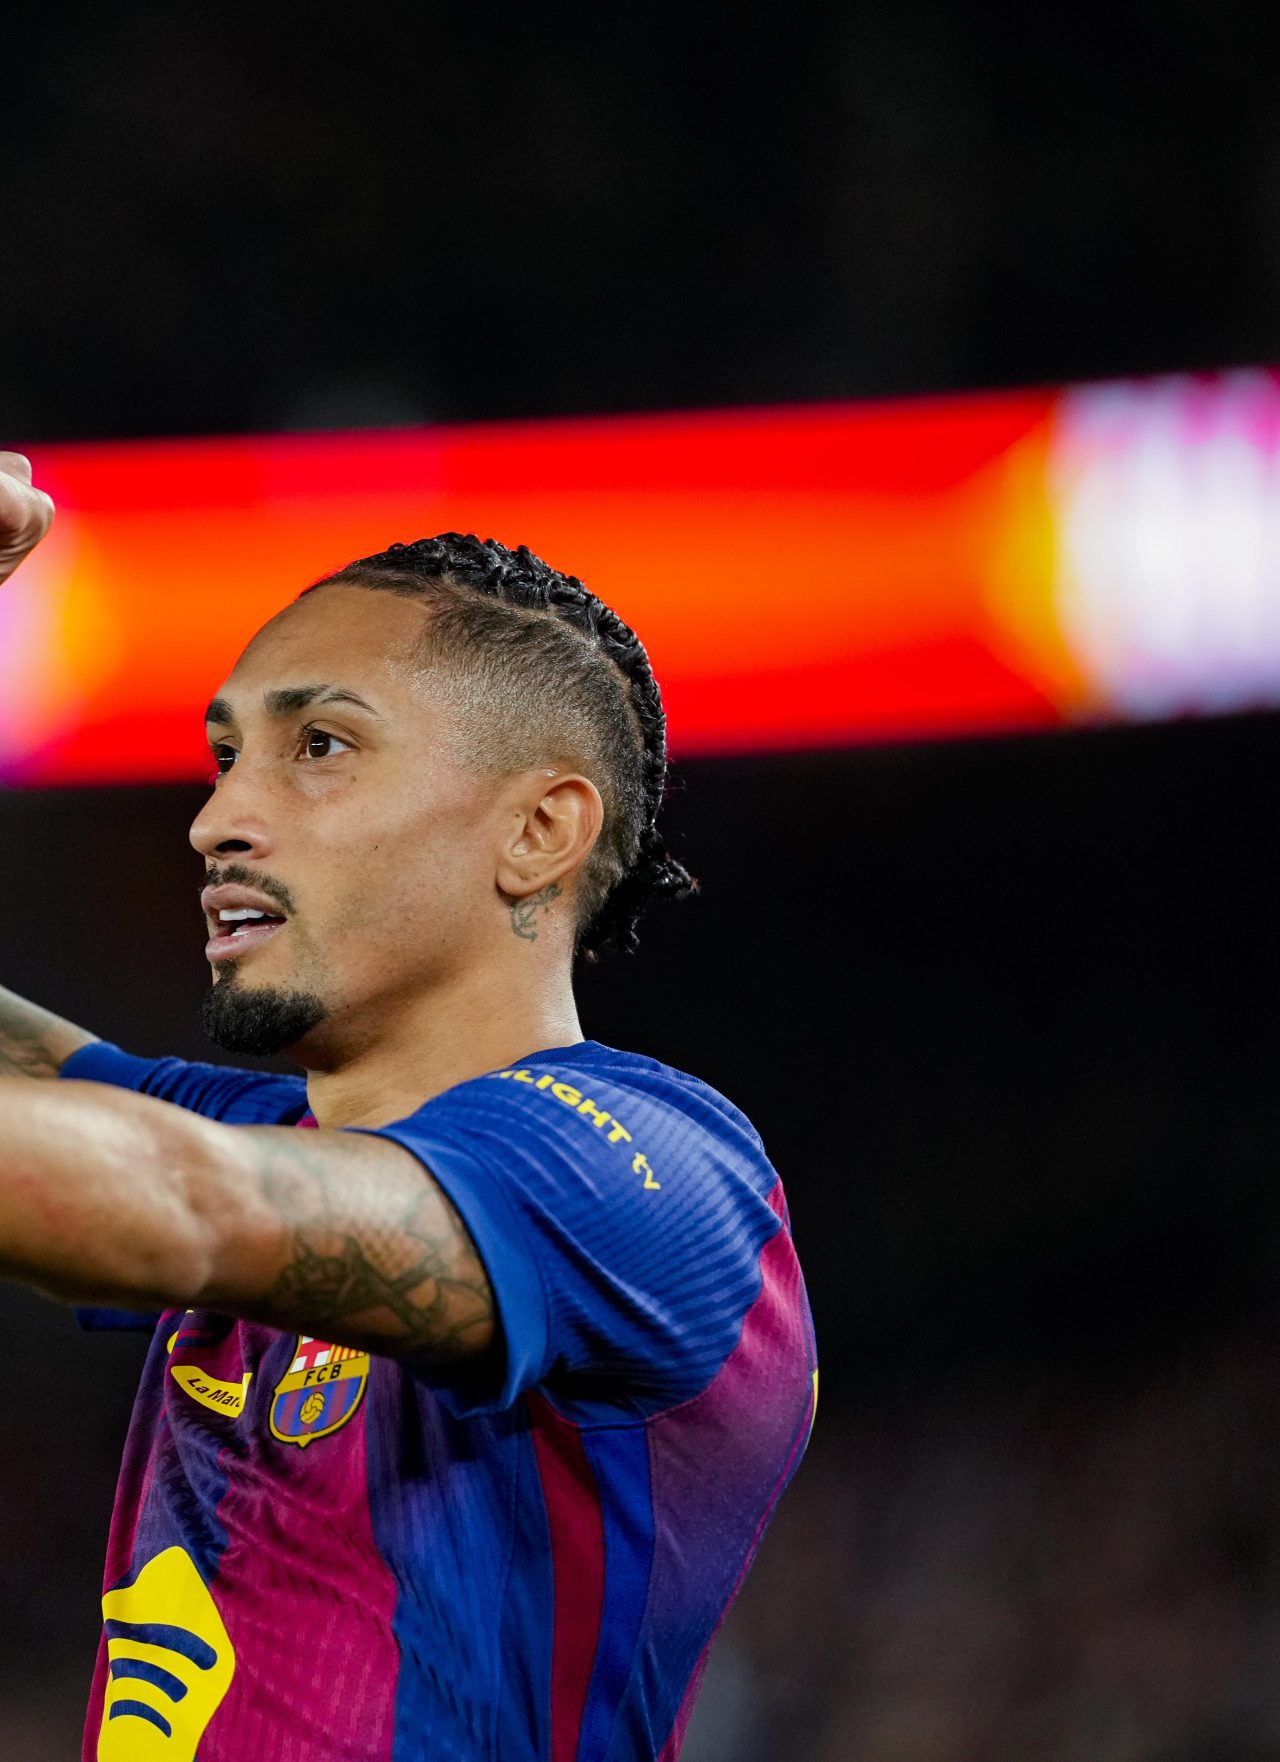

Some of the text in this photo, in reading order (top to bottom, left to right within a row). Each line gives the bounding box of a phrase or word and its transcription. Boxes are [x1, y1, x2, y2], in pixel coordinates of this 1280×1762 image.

[631, 1151, 662, 1191] tv
[187, 1377, 210, 1395] La
[303, 1363, 342, 1387] FCB
